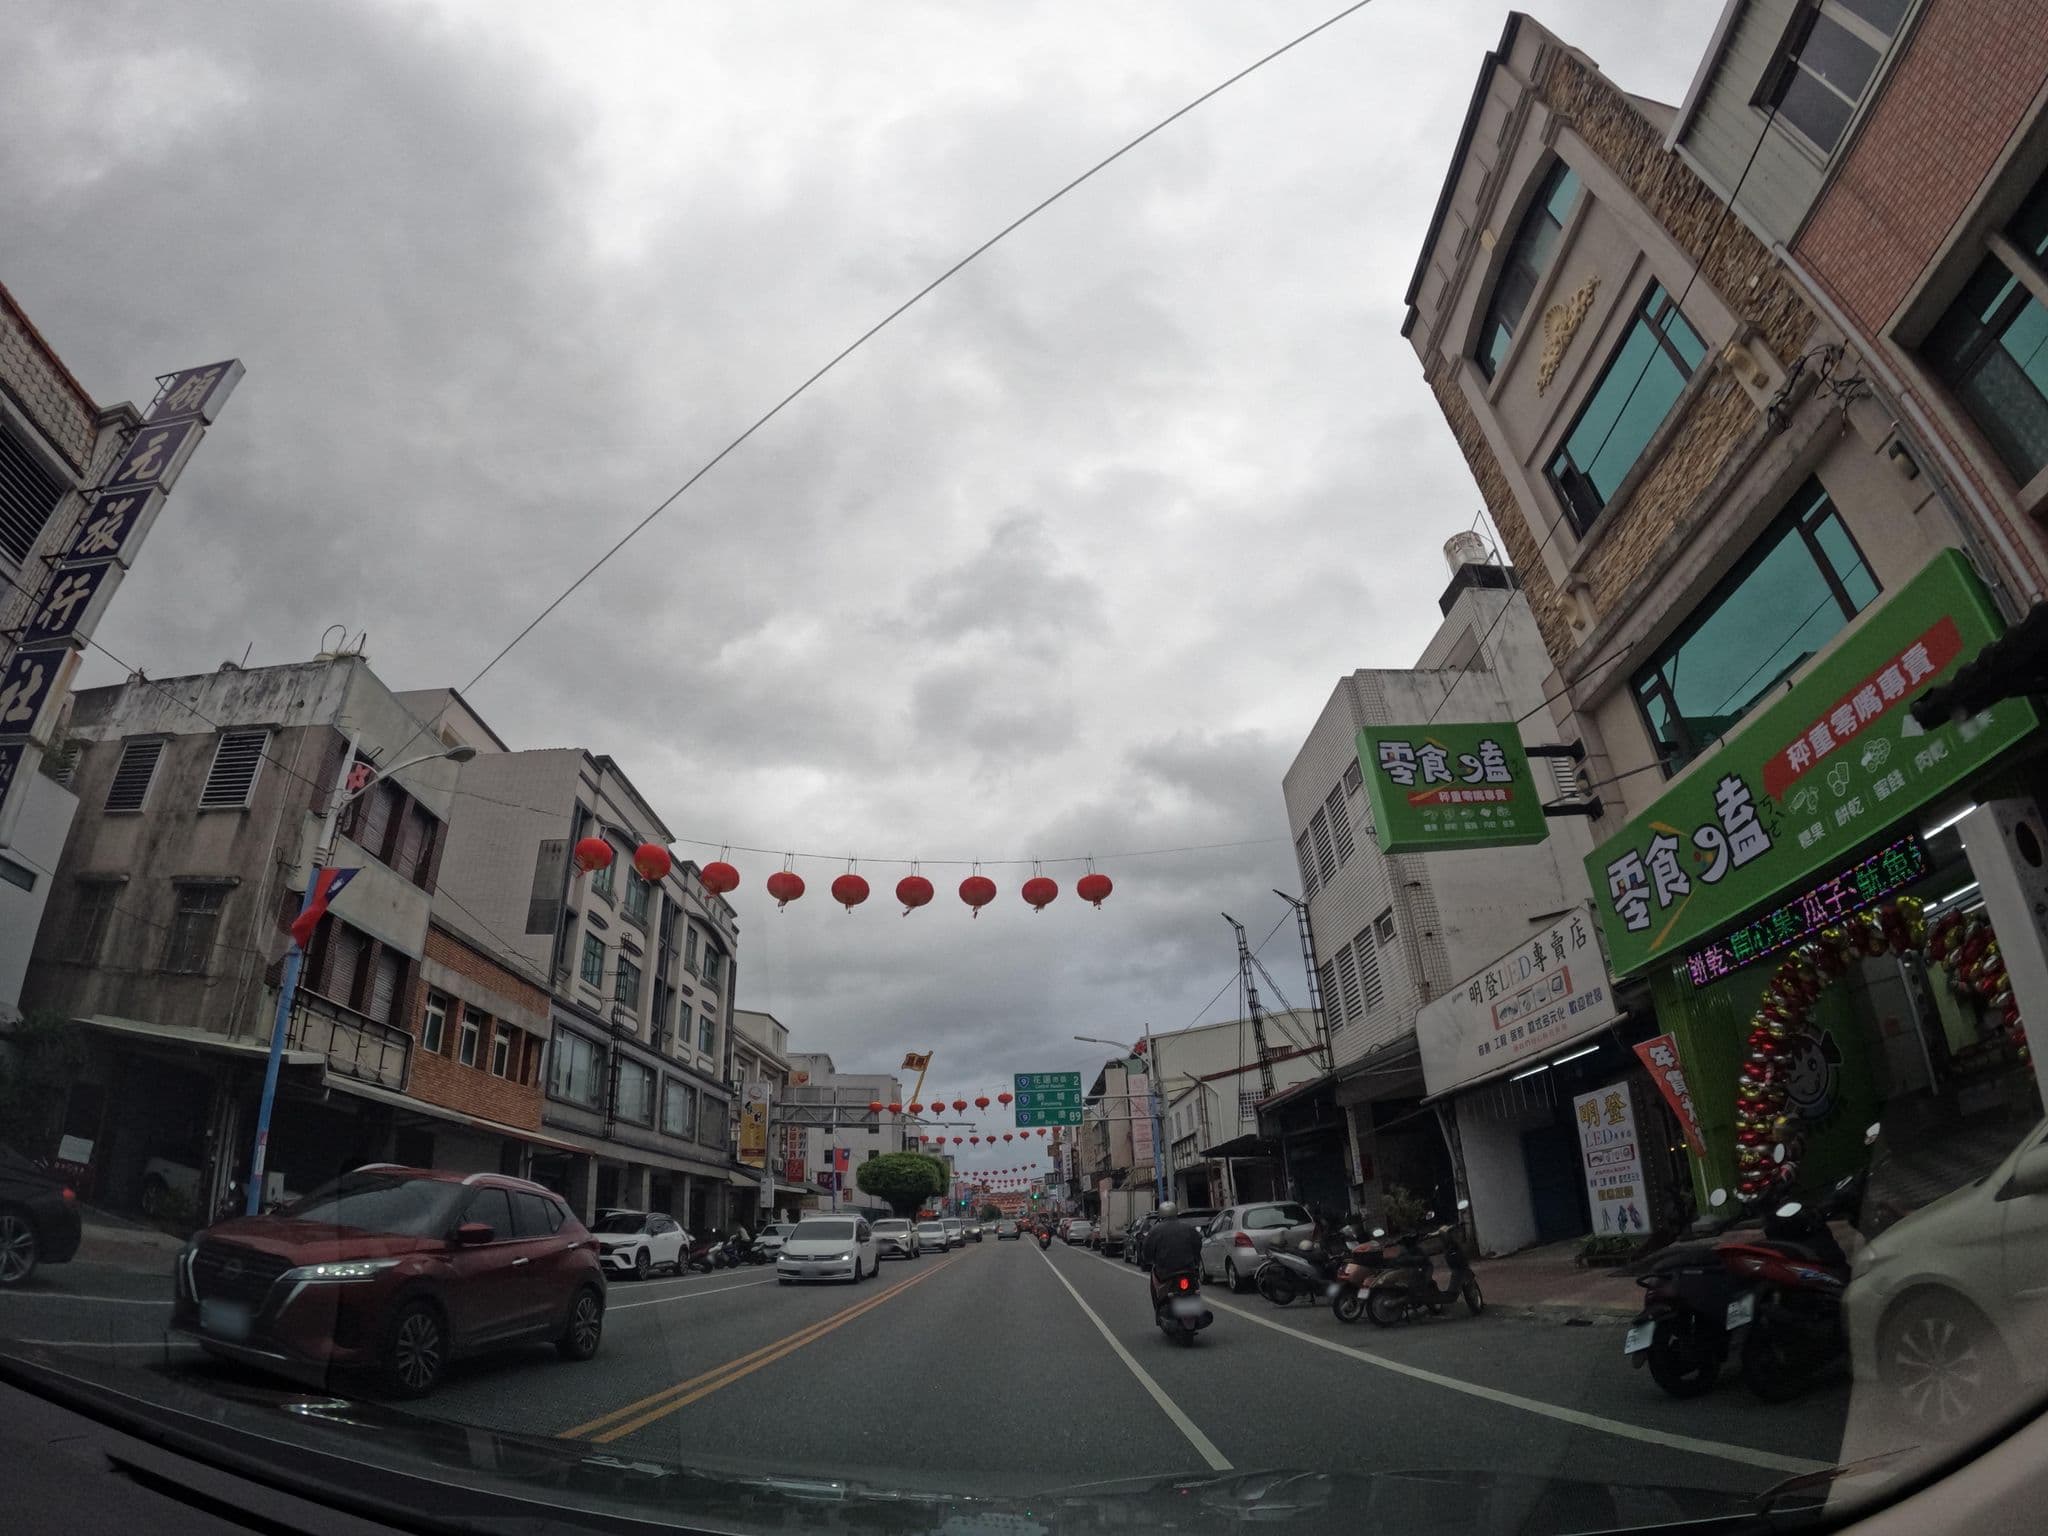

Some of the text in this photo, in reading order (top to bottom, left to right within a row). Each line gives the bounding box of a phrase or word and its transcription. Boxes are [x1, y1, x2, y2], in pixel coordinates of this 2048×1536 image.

[1786, 641, 1935, 773] 秤重零嘴專賣
[1834, 796, 1865, 827] 餅乾
[1073, 1076, 1080, 1086] 2
[1069, 1111, 1081, 1122] 89
[1578, 1091, 1628, 1129] 明登
